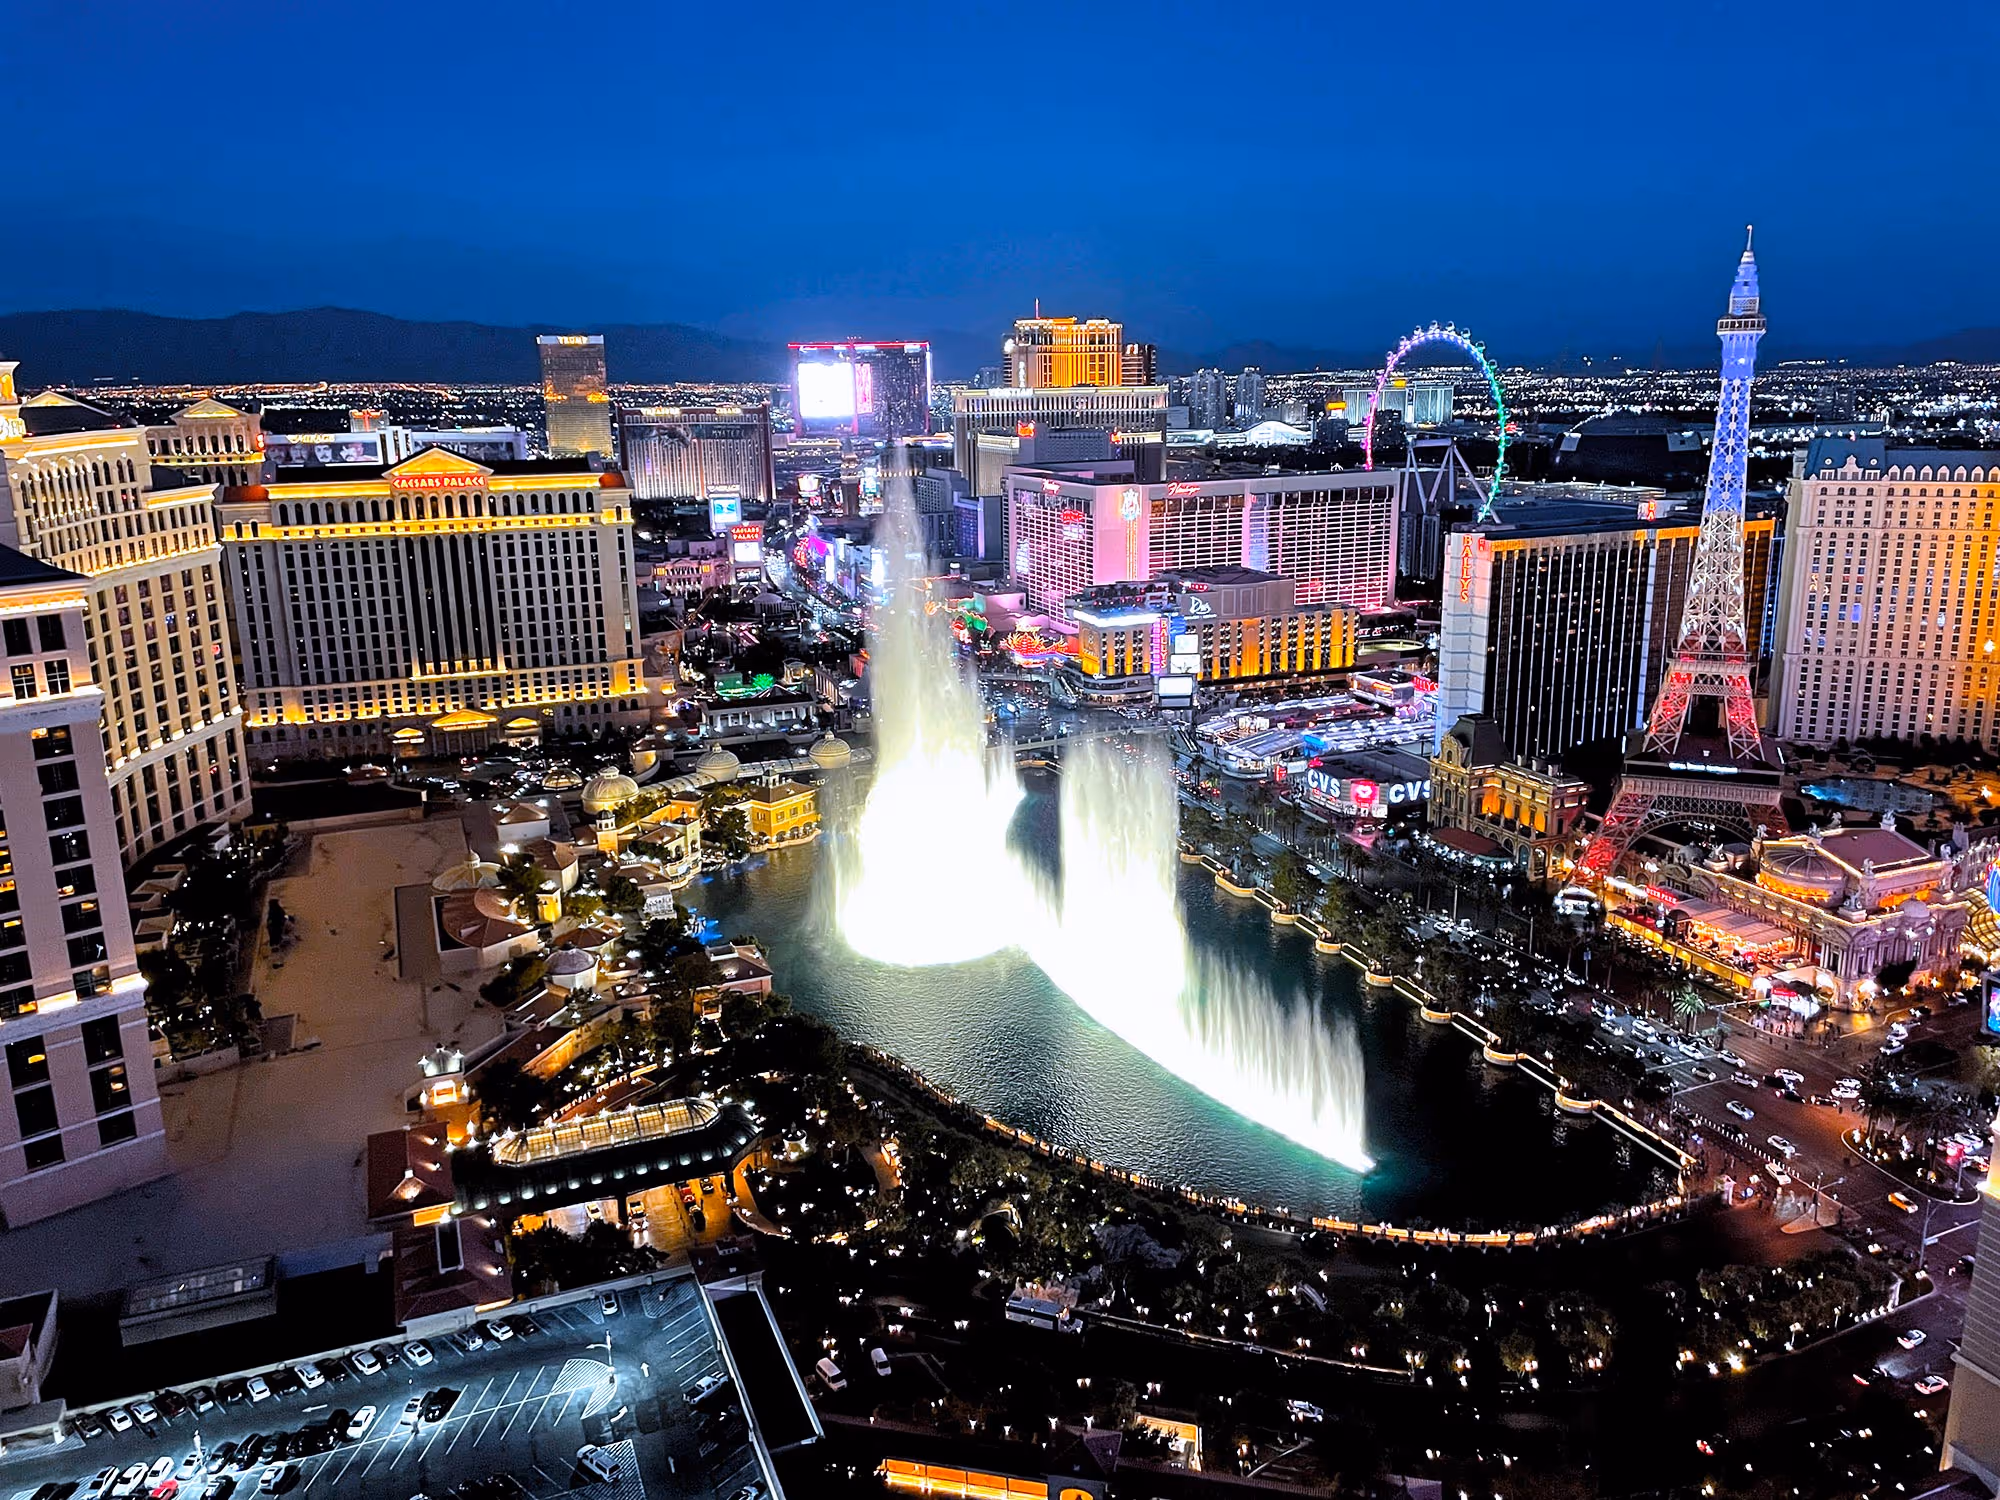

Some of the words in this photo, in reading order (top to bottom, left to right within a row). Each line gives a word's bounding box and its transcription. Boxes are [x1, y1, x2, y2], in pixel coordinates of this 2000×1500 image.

[393, 478, 441, 488] CAESARS
[443, 476, 485, 487] PALACE
[1168, 481, 1201, 495] Flamingo
[1307, 768, 1341, 798] CVS
